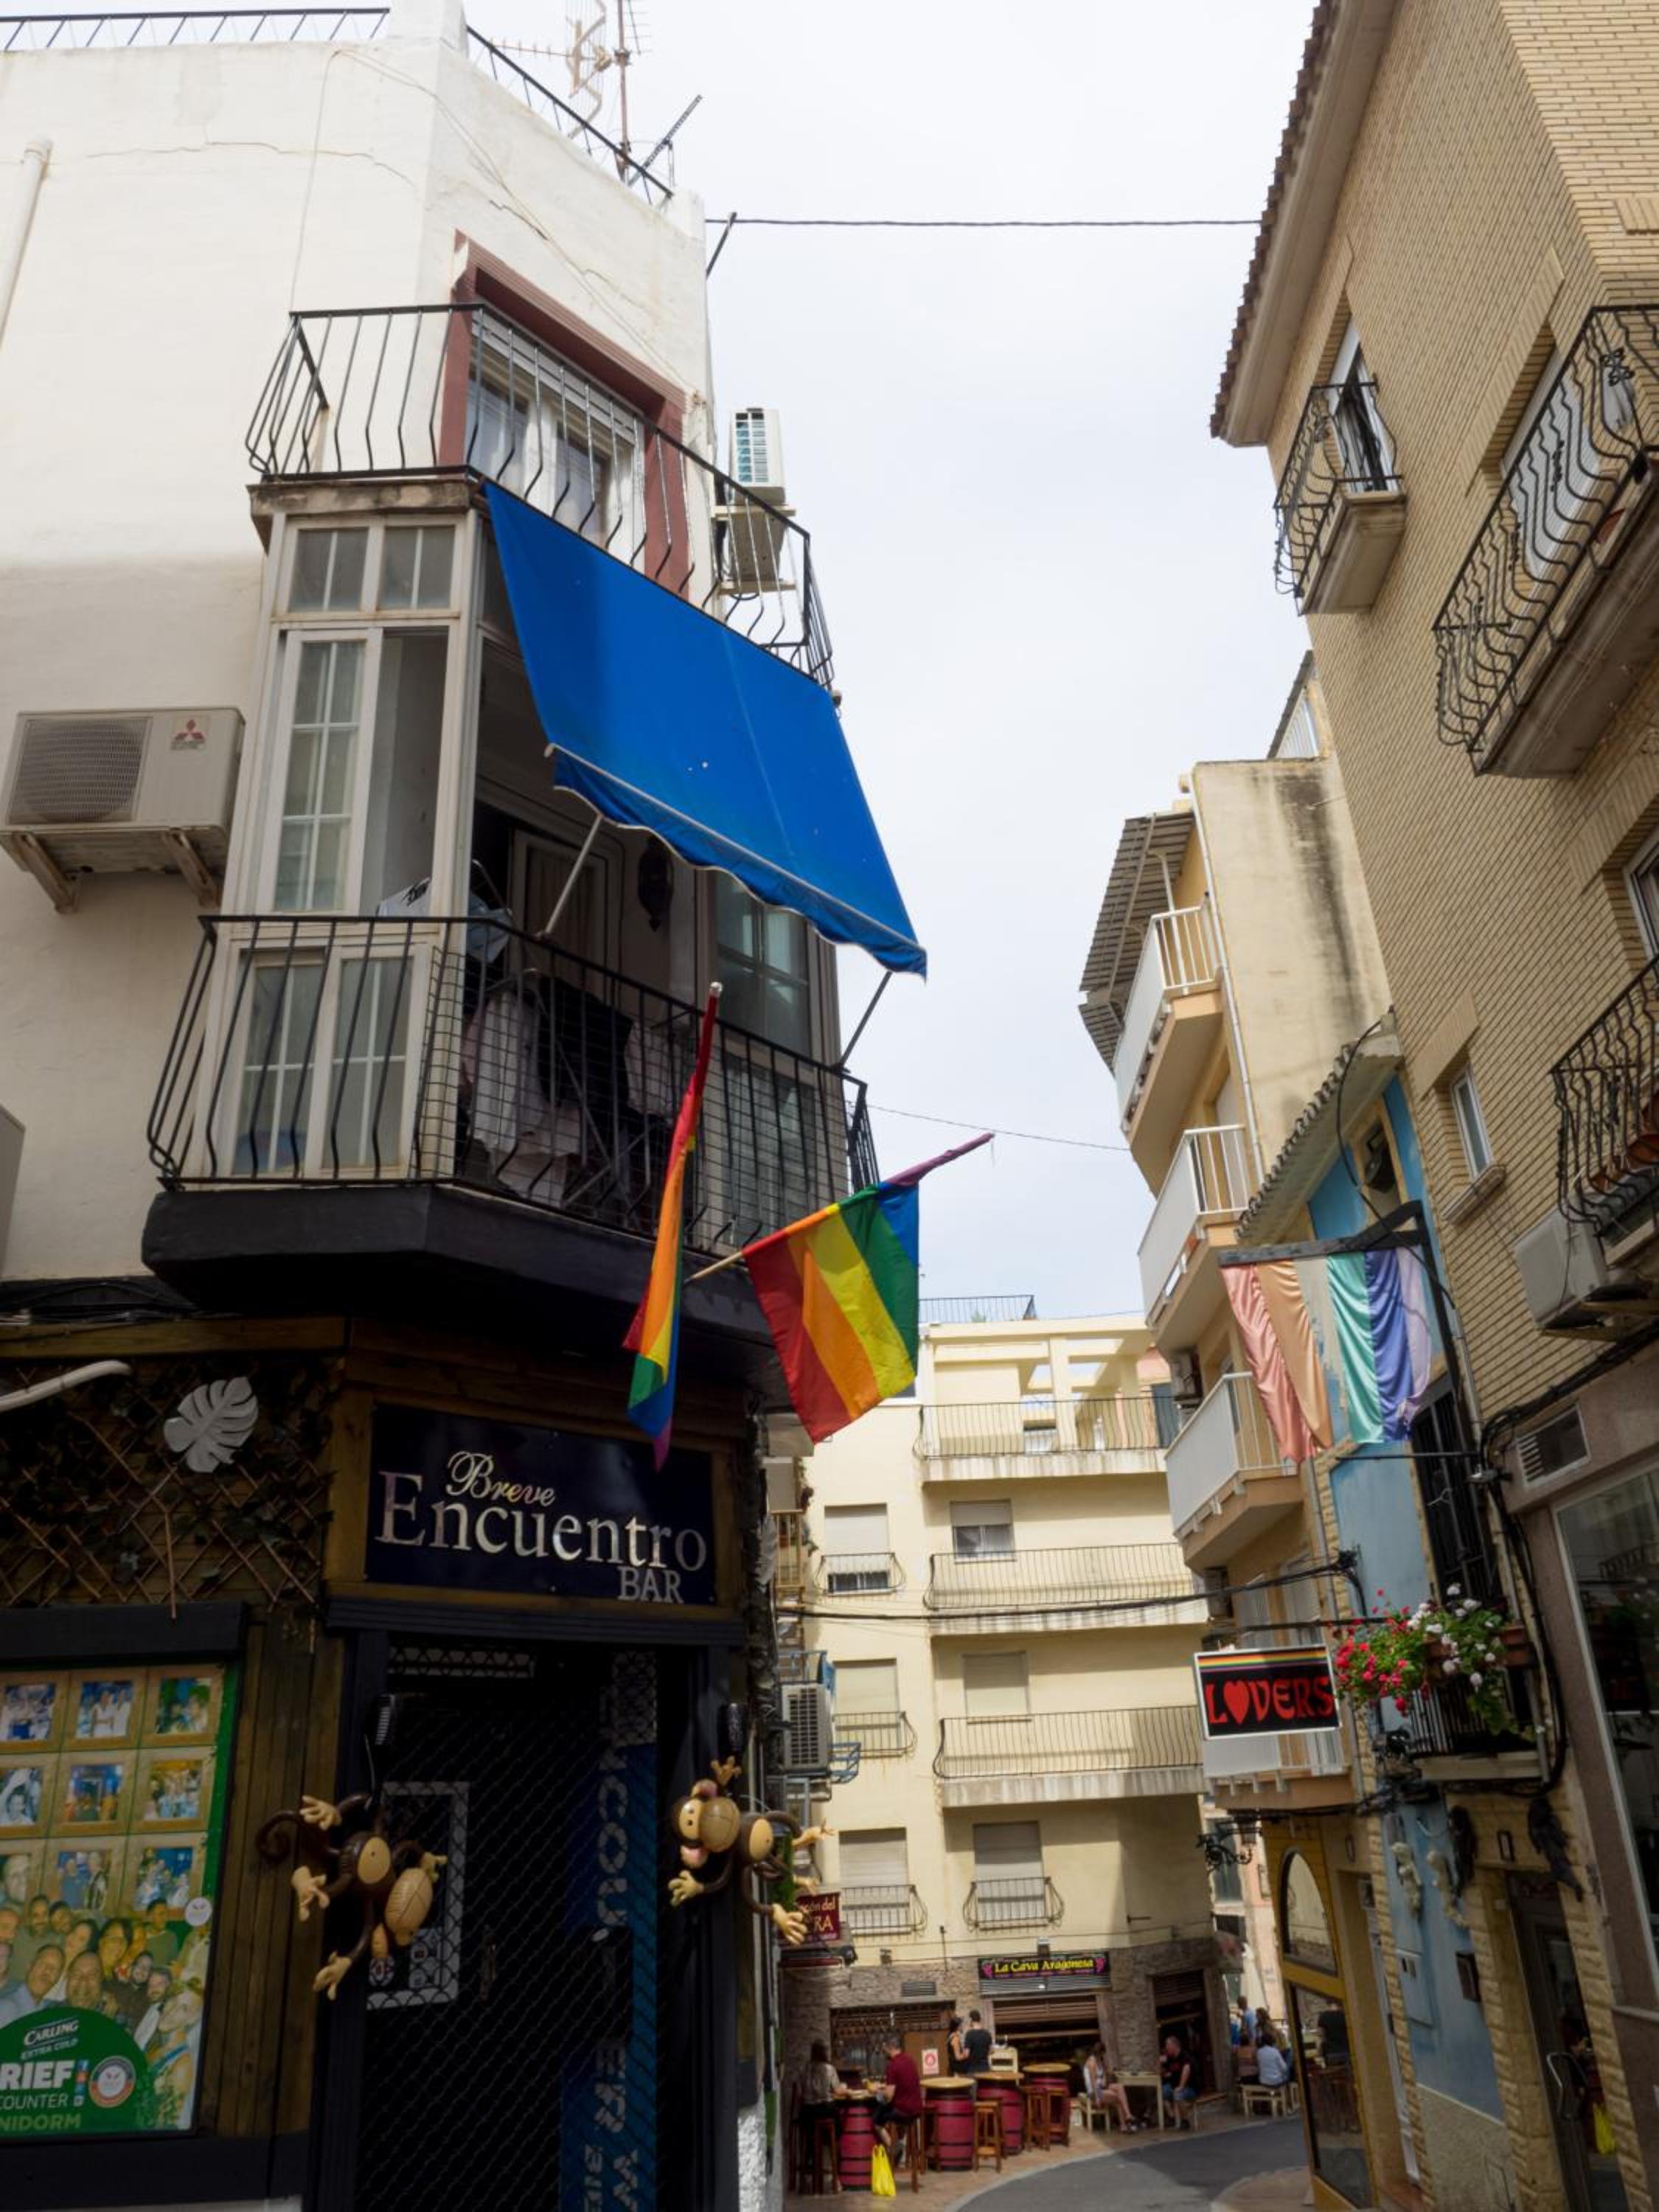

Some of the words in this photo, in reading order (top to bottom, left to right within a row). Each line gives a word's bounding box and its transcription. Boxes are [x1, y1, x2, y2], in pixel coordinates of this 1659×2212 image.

[446, 1450, 555, 1507] Breve
[375, 1470, 707, 1572] Encuentro
[618, 1565, 684, 1605] BAR
[995, 1962, 1009, 1973] La
[1011, 1960, 1039, 1972] Cava
[1042, 1958, 1093, 1970] Aragonesa
[24, 2020, 79, 2045] CARLING
